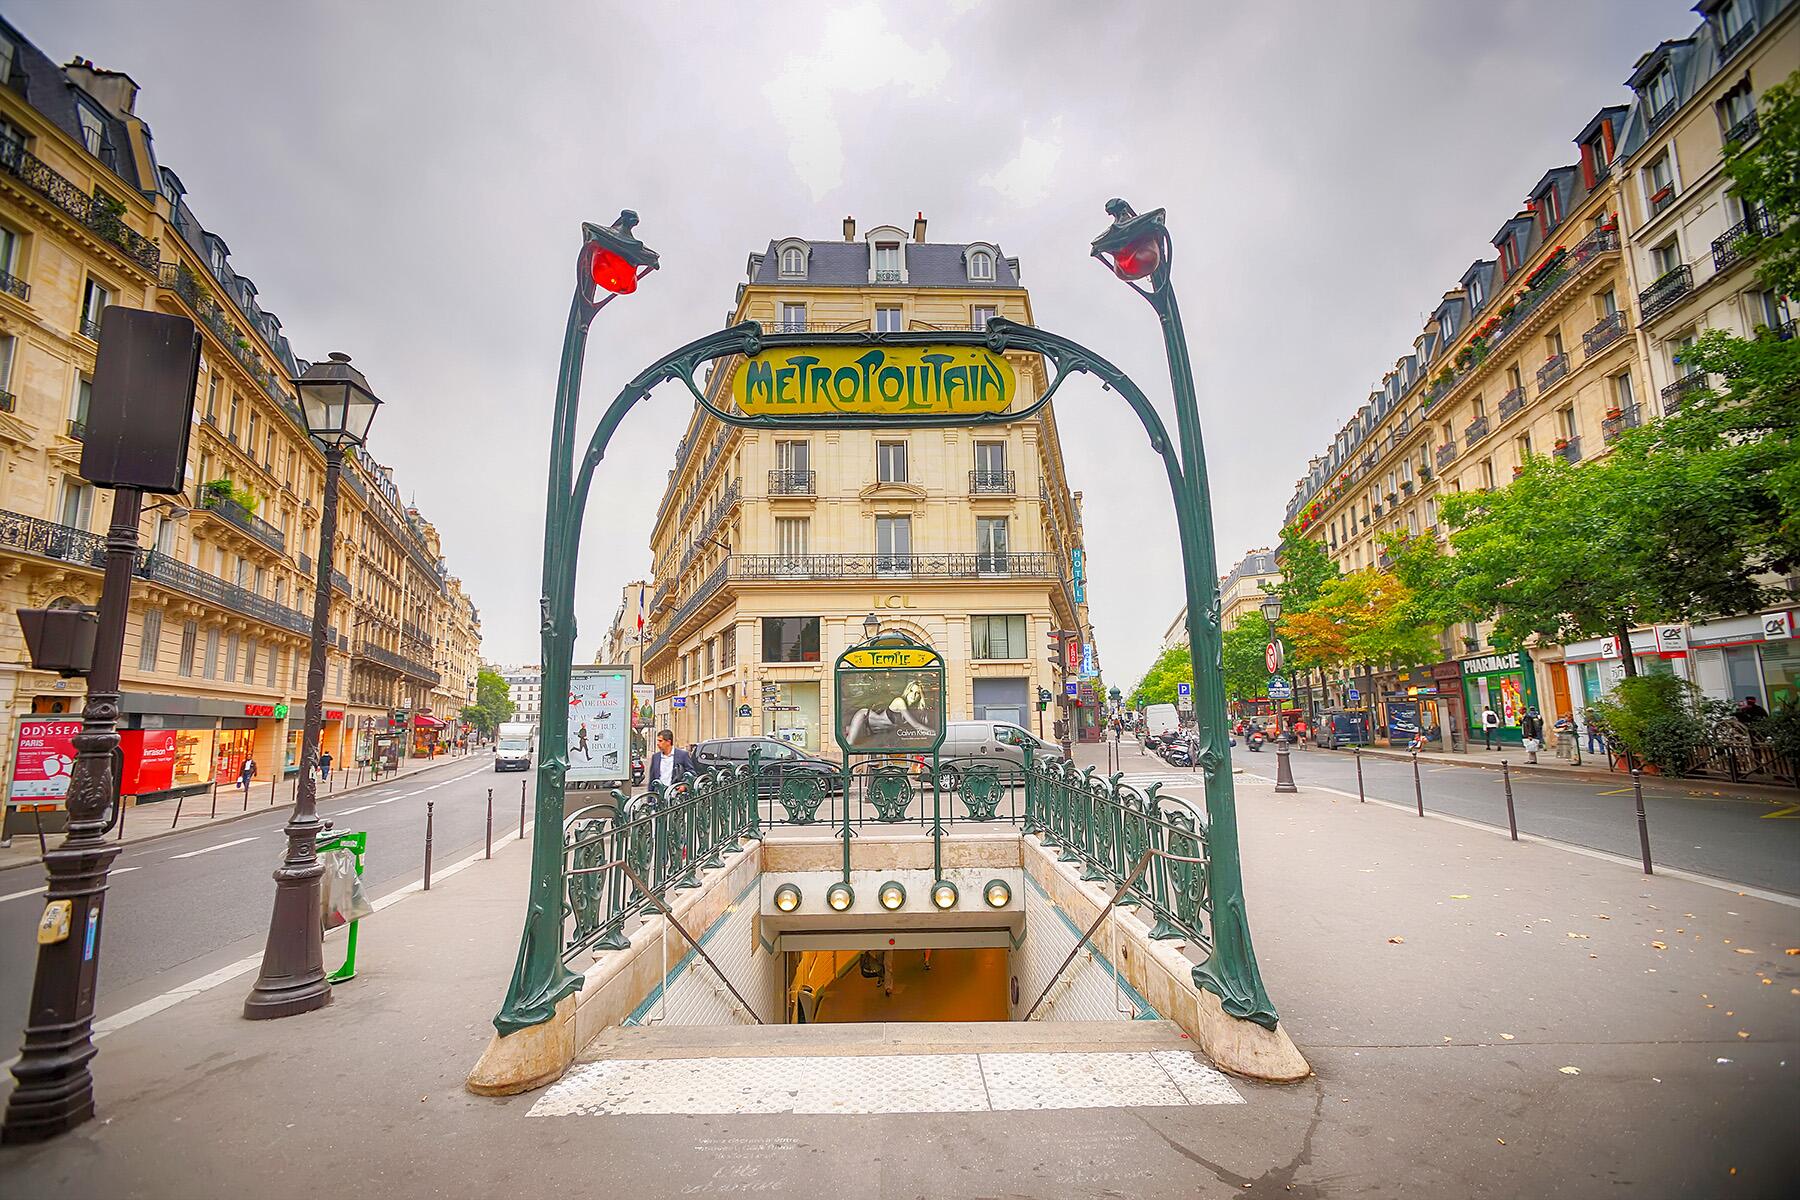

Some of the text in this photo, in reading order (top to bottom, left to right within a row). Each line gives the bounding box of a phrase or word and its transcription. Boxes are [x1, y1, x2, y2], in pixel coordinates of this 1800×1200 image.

[745, 349, 1006, 412] METROPOLITAIN
[873, 595, 917, 609] LCL
[1463, 653, 1520, 674] PHARMACIE
[1181, 685, 1188, 694] P
[896, 729, 916, 737] Calvin
[20, 739, 44, 747] PARIS
